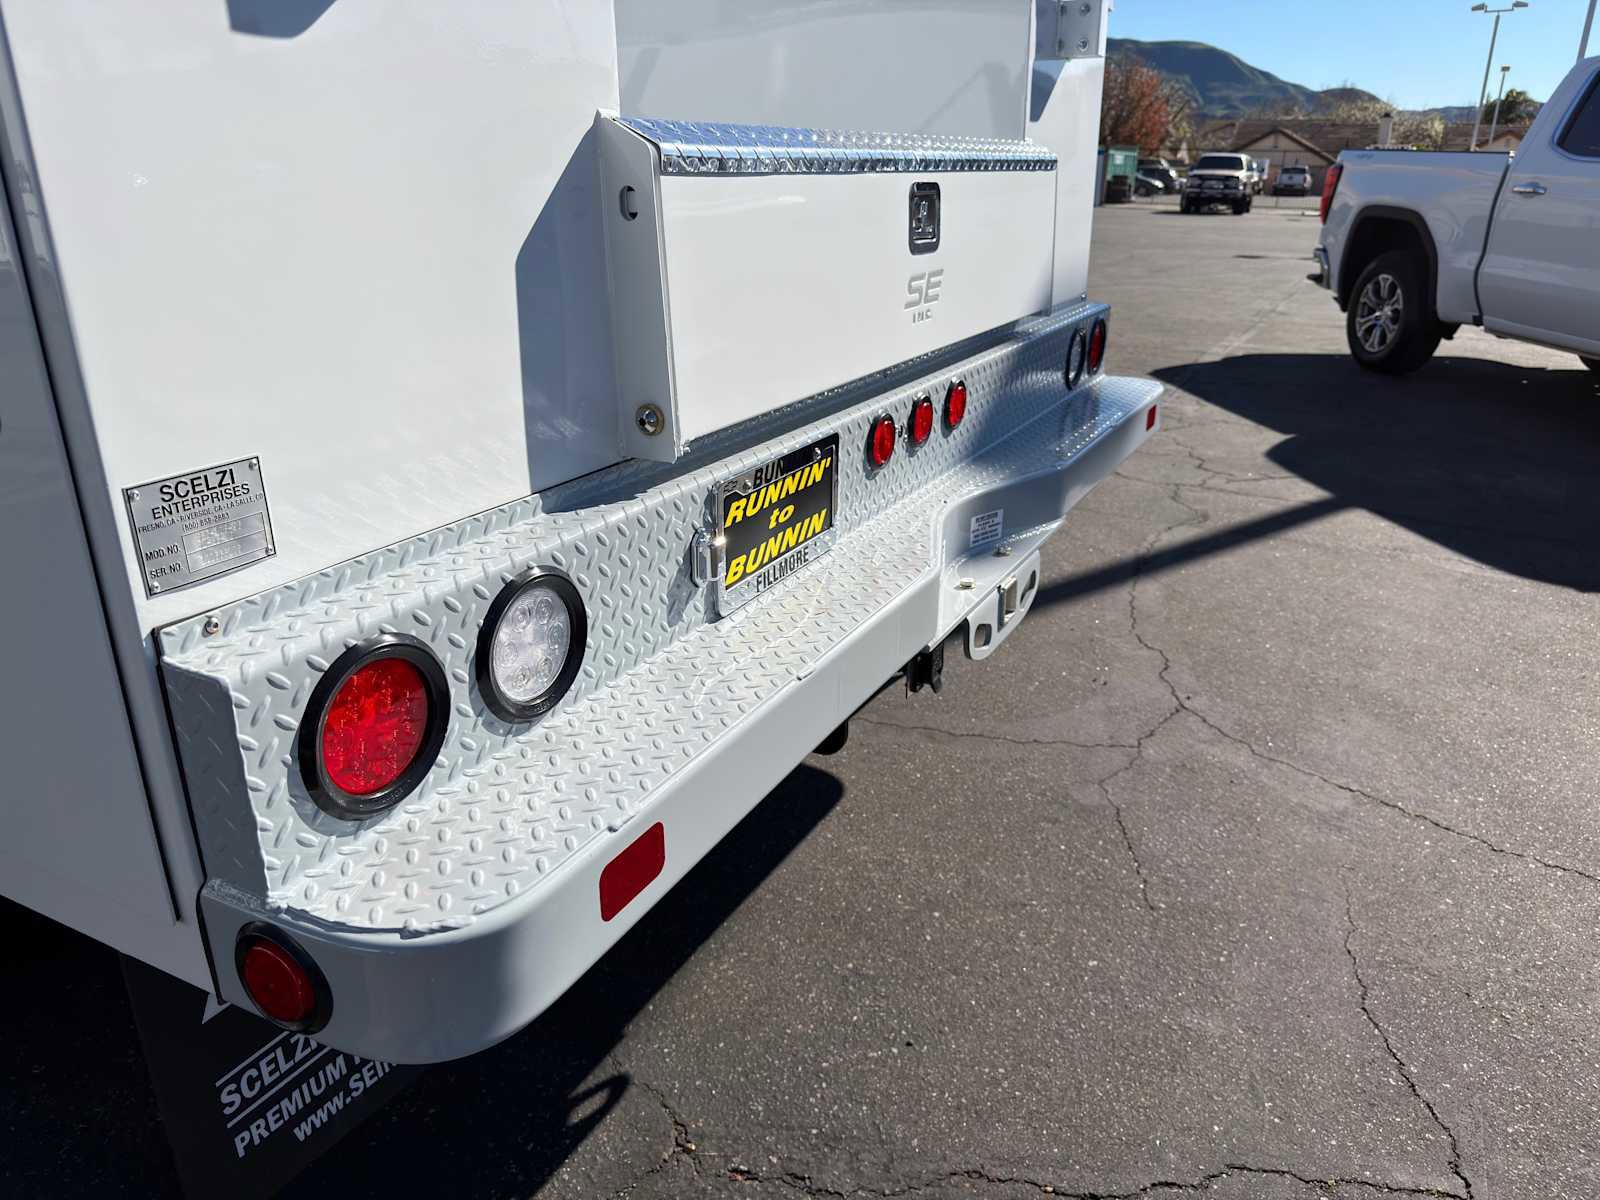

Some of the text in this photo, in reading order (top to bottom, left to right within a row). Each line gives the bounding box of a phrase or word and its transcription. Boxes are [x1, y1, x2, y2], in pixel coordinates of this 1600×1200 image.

[904, 268, 944, 310] SE
[151, 483, 251, 520] ENTERPRISES
[160, 468, 236, 503] SCELZI
[769, 504, 795, 530] to
[725, 508, 828, 587] BUNNIN
[756, 546, 809, 593] FILLMORE
[233, 1053, 348, 1159] PREMIUM
